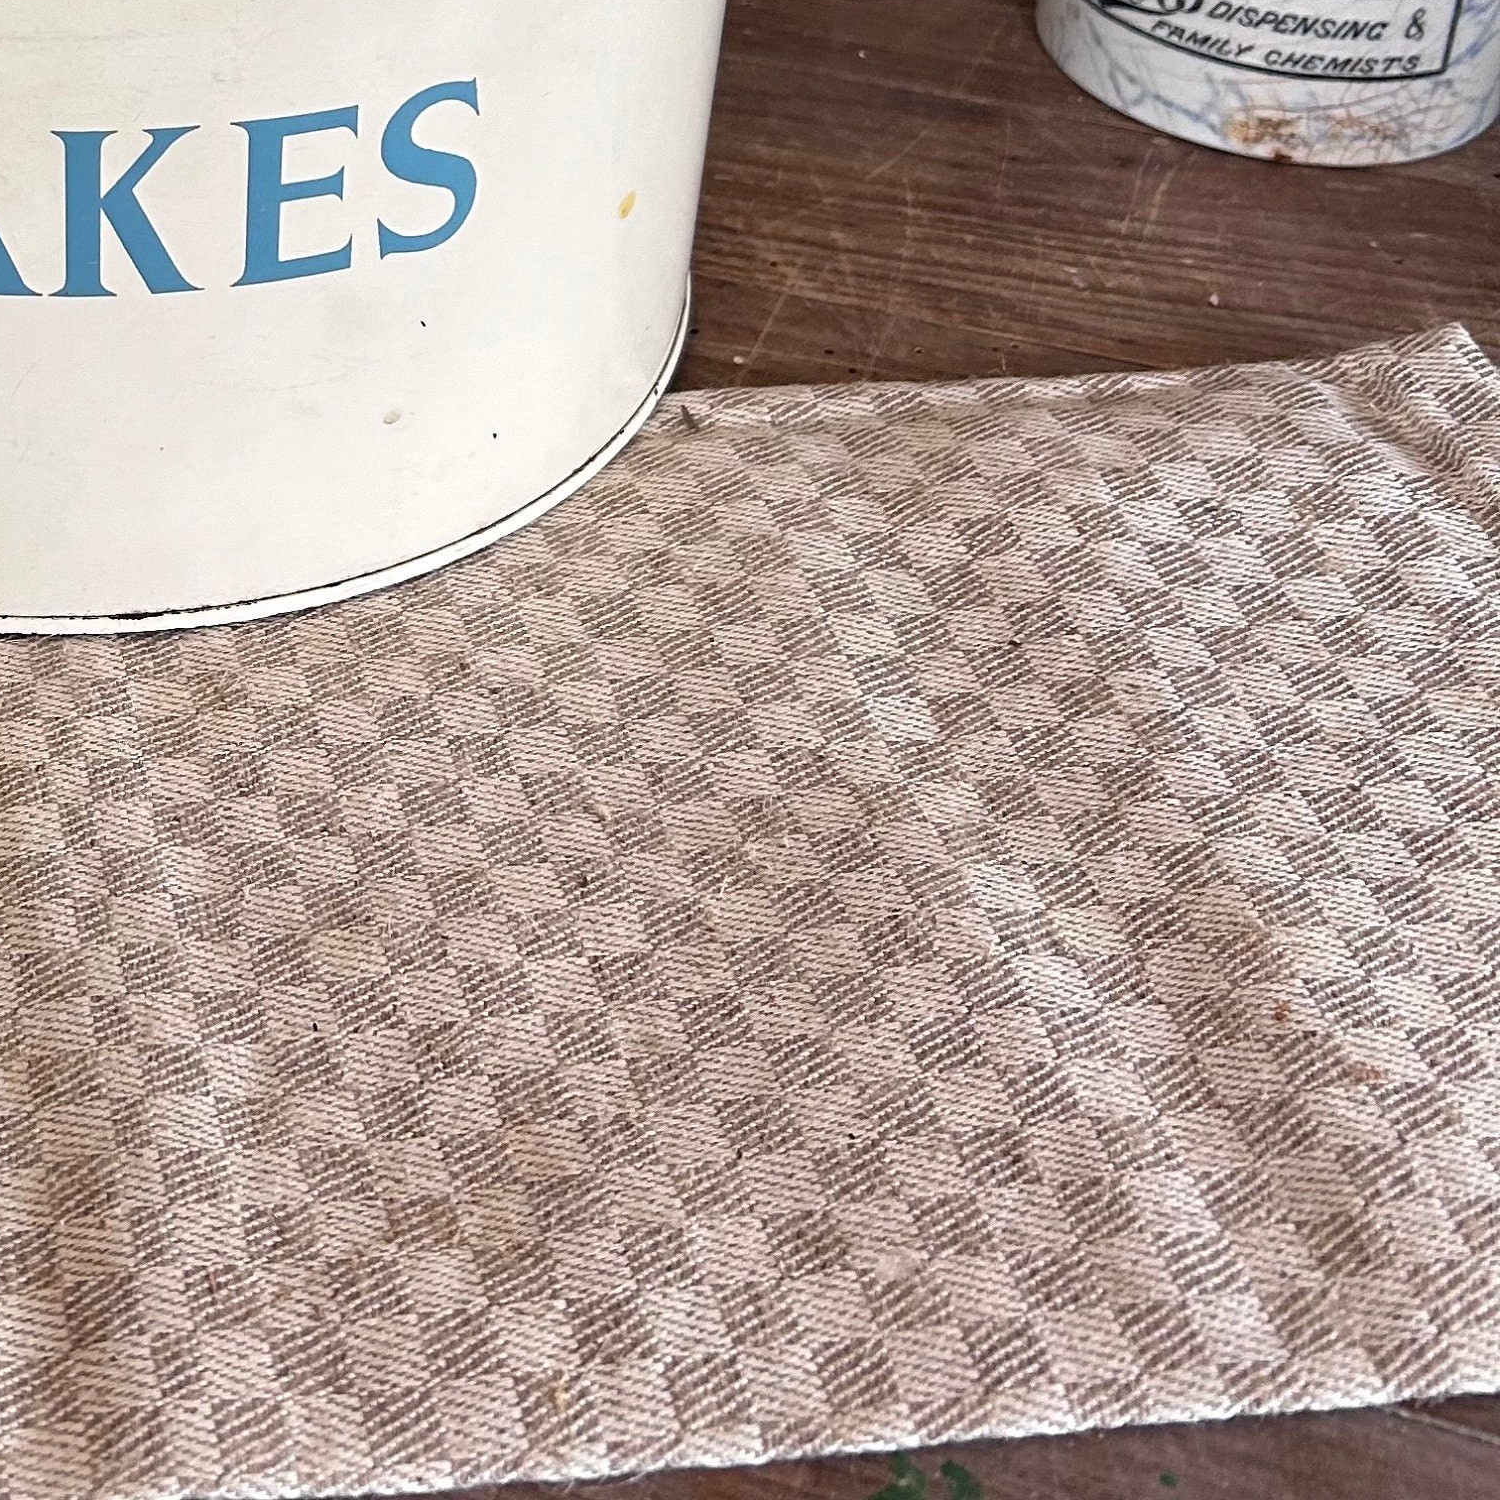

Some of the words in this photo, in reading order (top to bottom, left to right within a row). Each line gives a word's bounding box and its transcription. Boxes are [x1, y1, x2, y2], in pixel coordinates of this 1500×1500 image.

[1208, 0, 1389, 41] DISPENSING
[1404, 6, 1427, 41] &
[1150, 19, 1255, 57] FAMILY
[1263, 48, 1422, 74] CHEMISTS
